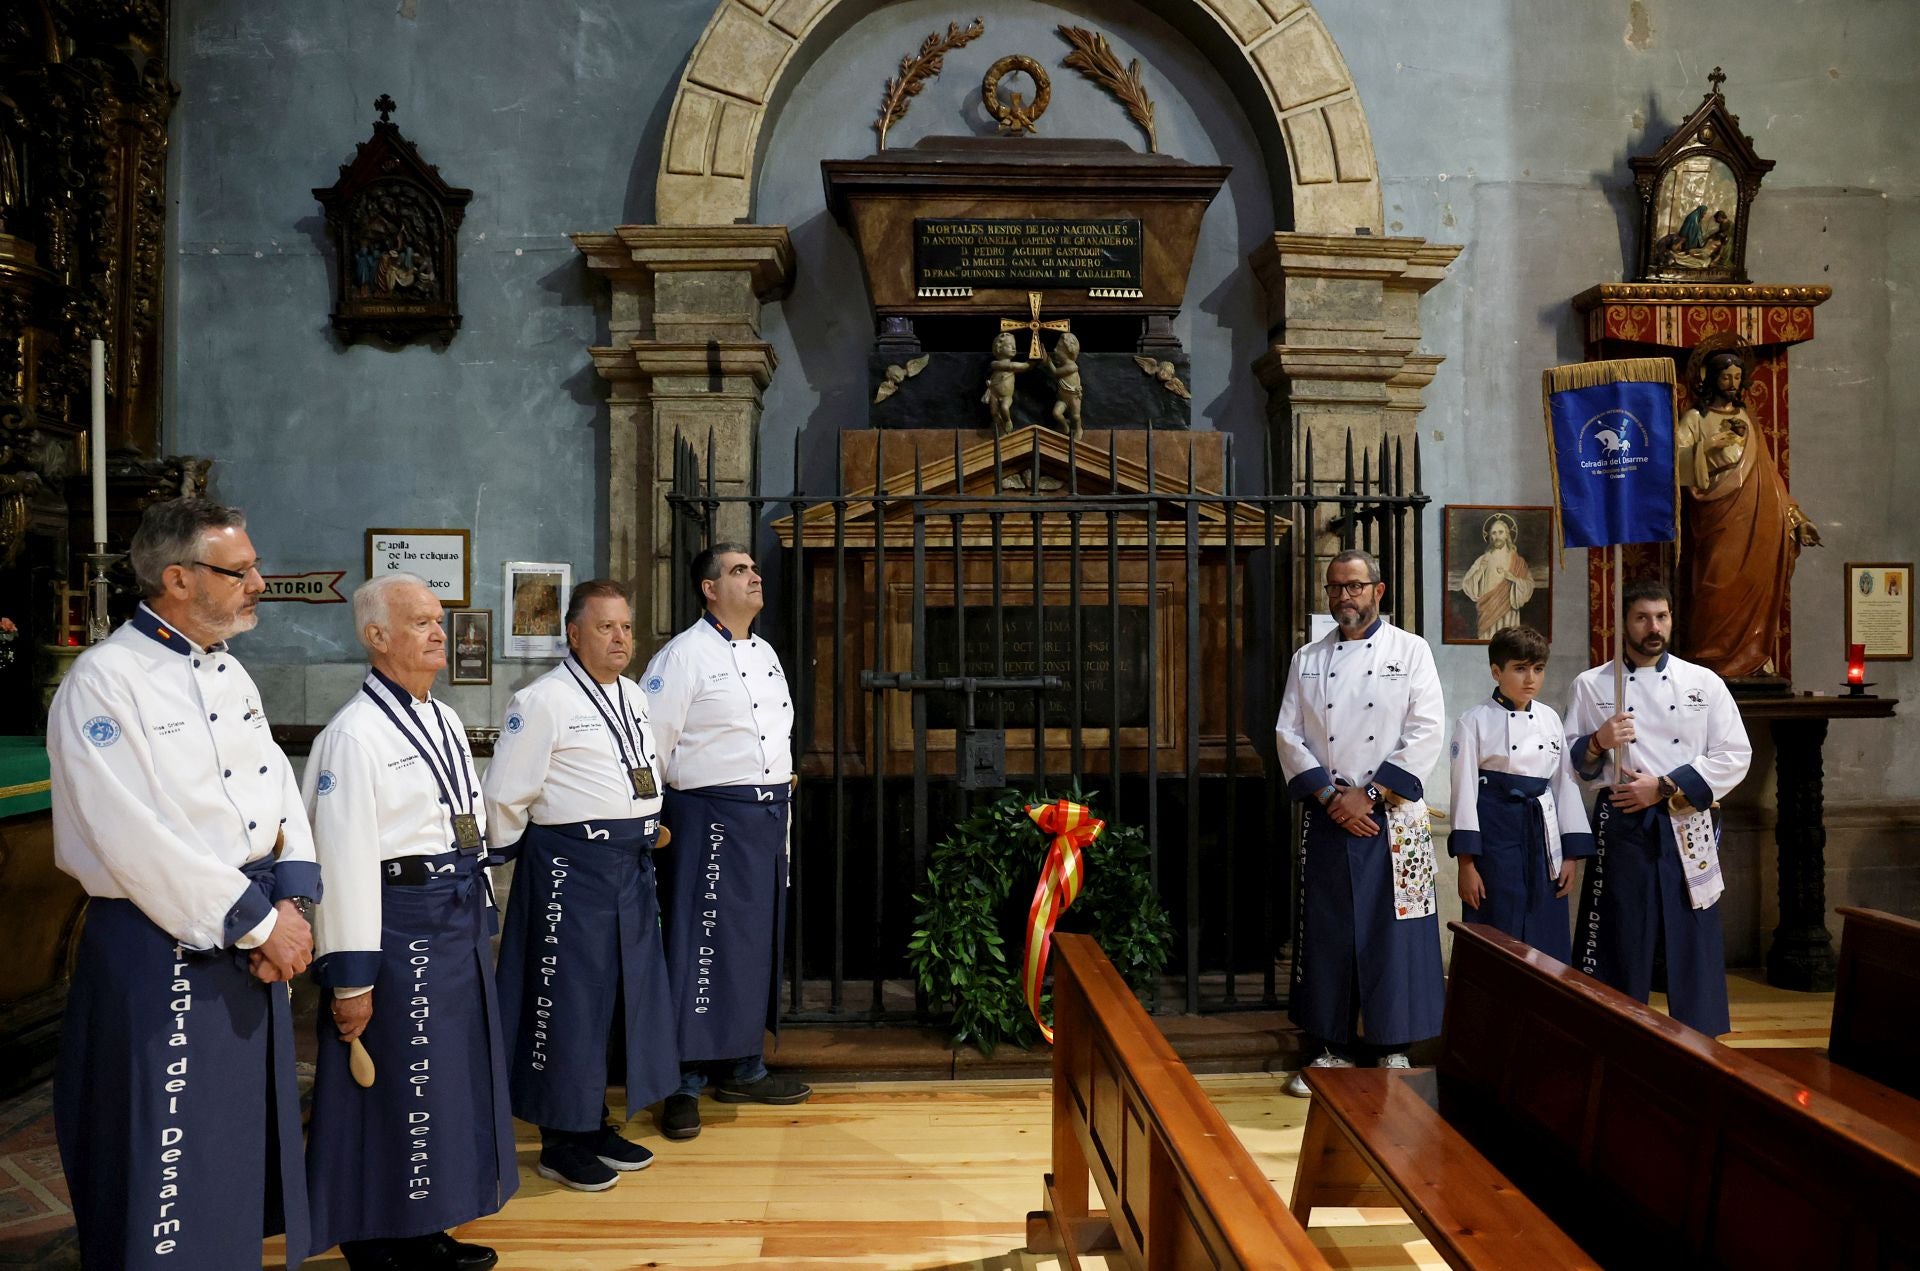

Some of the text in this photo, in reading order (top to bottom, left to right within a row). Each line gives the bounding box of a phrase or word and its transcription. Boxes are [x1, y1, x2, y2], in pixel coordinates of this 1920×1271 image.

[926, 224, 1128, 235] MORTALES RESTOS DE LOS NACIONALES
[932, 236, 974, 245] ANTONIO
[974, 246, 1005, 256] PEDRO
[973, 258, 1006, 267] MIGUEL
[1010, 269, 1055, 278] NACIONAL
[1059, 269, 1071, 278] DE
[1609, 457, 1621, 465] del
[376, 541, 410, 552] Capilla
[388, 551, 459, 561] de las reliquias
[387, 561, 400, 570] de
[262, 581, 323, 595] ATORIO
[1592, 879, 1603, 906] del
[695, 823, 725, 1014] Cofradía del Desarme
[1582, 912, 1600, 974] Desarme
[532, 857, 569, 1071] Cofradía del Desarme
[408, 939, 430, 1200] Cofradía del Desarme
[153, 944, 192, 1256] fradía del Desarme
